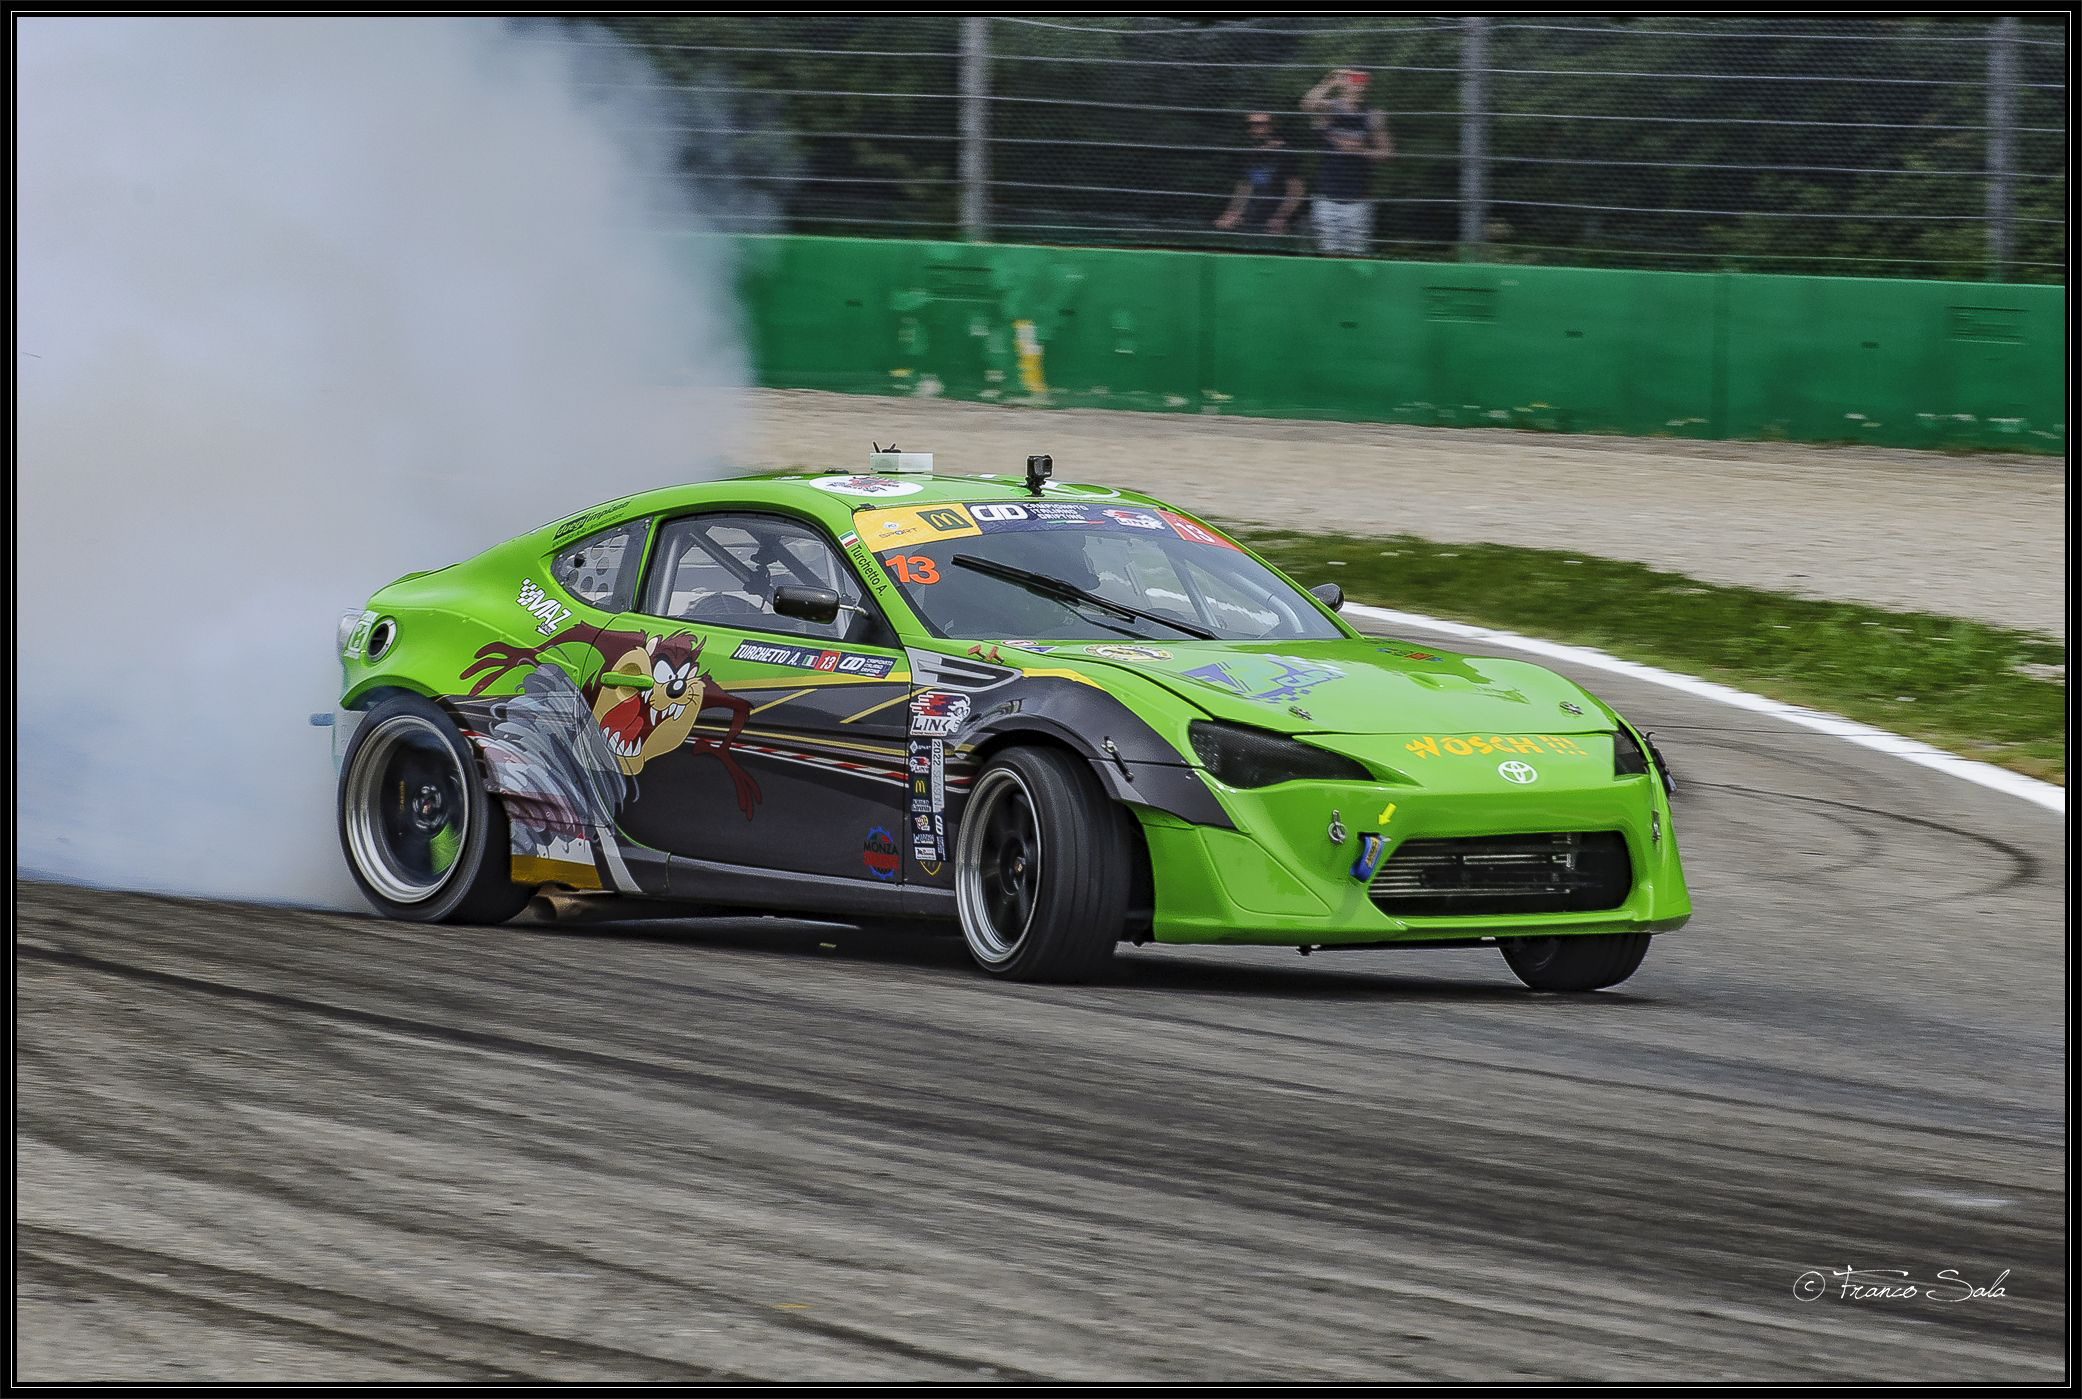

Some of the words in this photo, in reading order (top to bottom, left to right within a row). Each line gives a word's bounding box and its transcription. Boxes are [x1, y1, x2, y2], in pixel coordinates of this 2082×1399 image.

[1022, 503, 1089, 511] CAMPIONATO
[1175, 519, 1216, 543] 13
[851, 544, 881, 586] Turchetto
[876, 584, 888, 597] A.
[885, 553, 941, 585] 13
[734, 644, 791, 664] TURCHETTO
[788, 653, 798, 666] A.
[819, 655, 836, 671] 13
[912, 717, 951, 732] LINK
[933, 741, 942, 766] 2022
[1405, 735, 1545, 760] WOSCH
[863, 840, 899, 855] MONZA
